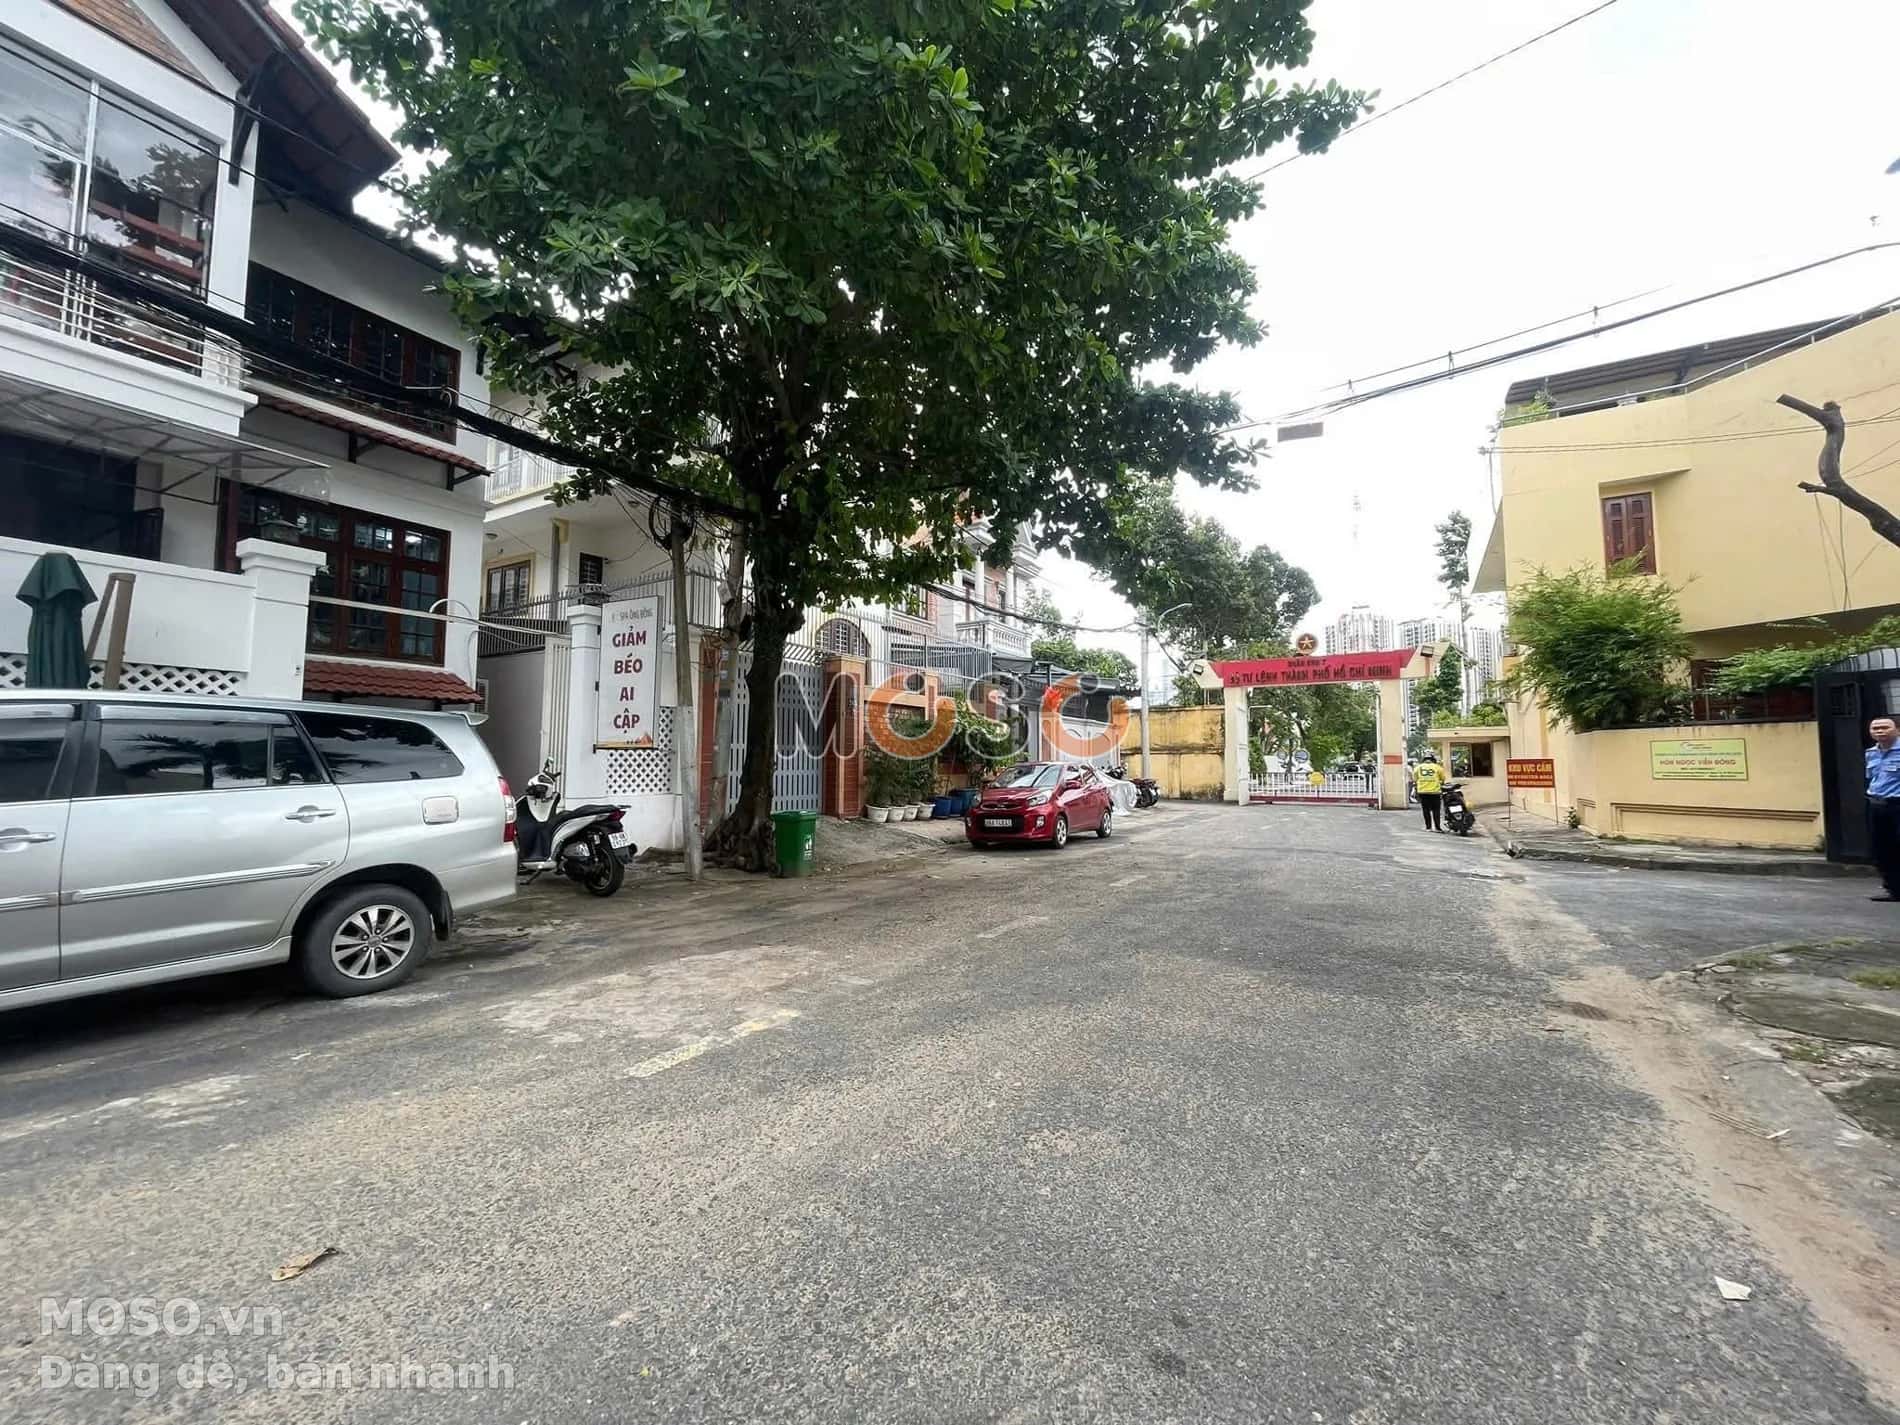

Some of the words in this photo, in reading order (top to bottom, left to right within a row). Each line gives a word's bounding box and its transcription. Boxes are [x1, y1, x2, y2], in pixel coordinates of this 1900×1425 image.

[612, 626, 647, 648] GIẢM
[614, 653, 643, 675] BÉO
[1255, 669, 1278, 683] LỆNH
[1281, 669, 1309, 682] THÀNH
[1312, 665, 1331, 680] PHỐ
[1333, 664, 1346, 679] HỒ
[1349, 664, 1366, 678] CHÍ
[620, 686, 634, 701] AI
[613, 708, 640, 733] CẬP
[1676, 759, 1696, 767] NGỌC
